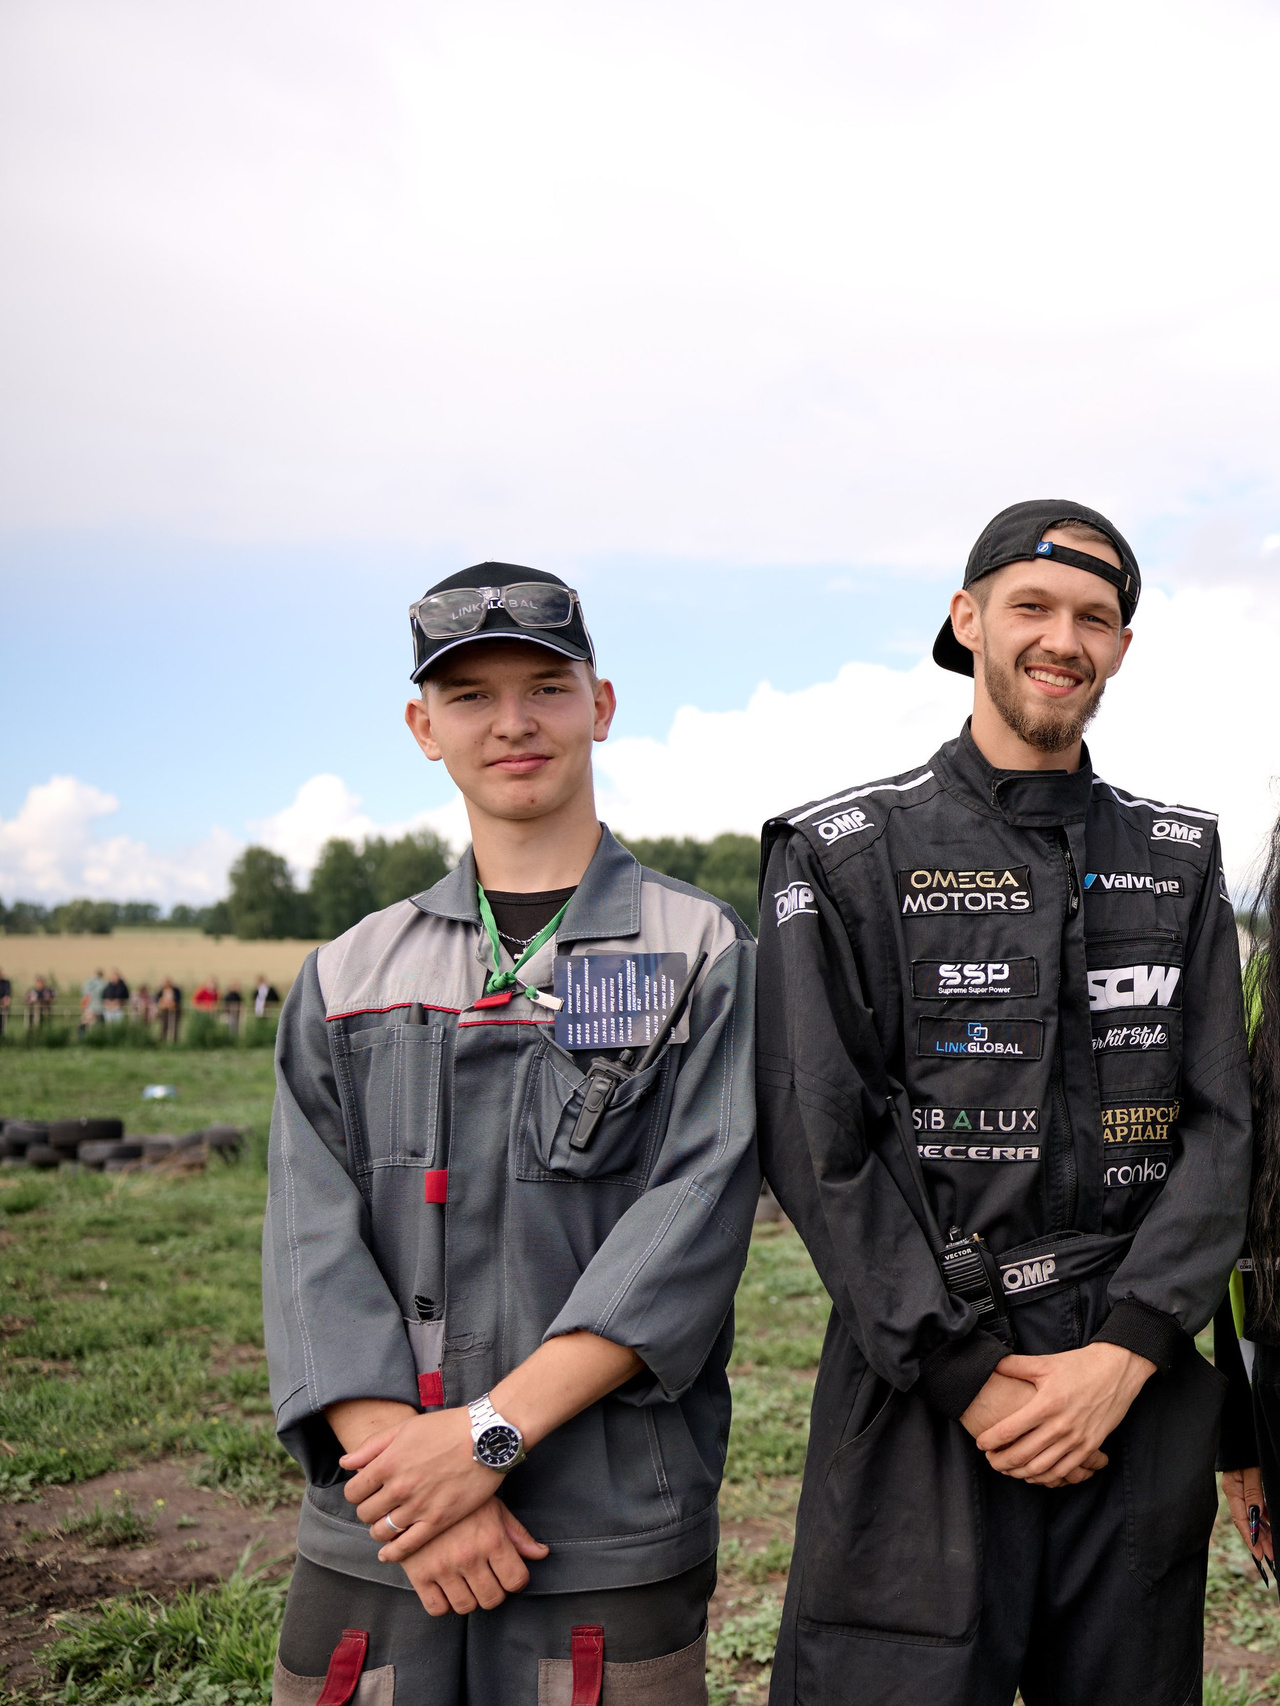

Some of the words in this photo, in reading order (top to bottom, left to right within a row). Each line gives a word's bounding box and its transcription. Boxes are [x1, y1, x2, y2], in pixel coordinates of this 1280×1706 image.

[818, 810, 866, 840] OMP
[1152, 822, 1202, 841] OMP
[910, 870, 1019, 889] OMEGA
[776, 887, 815, 919] OMP
[902, 891, 1030, 914] MOTORS
[939, 963, 1010, 987] SSP
[938, 987, 967, 995] Supreme
[968, 986, 988, 994] Super
[936, 1041, 1024, 1055] LINKGLOBAL
[1129, 1024, 1168, 1050] Style
[1103, 1124, 1169, 1143] АРДАН
[1104, 1158, 1167, 1186] ronko
[944, 1248, 972, 1261] VECTOR
[1003, 1258, 1056, 1290] OMP
